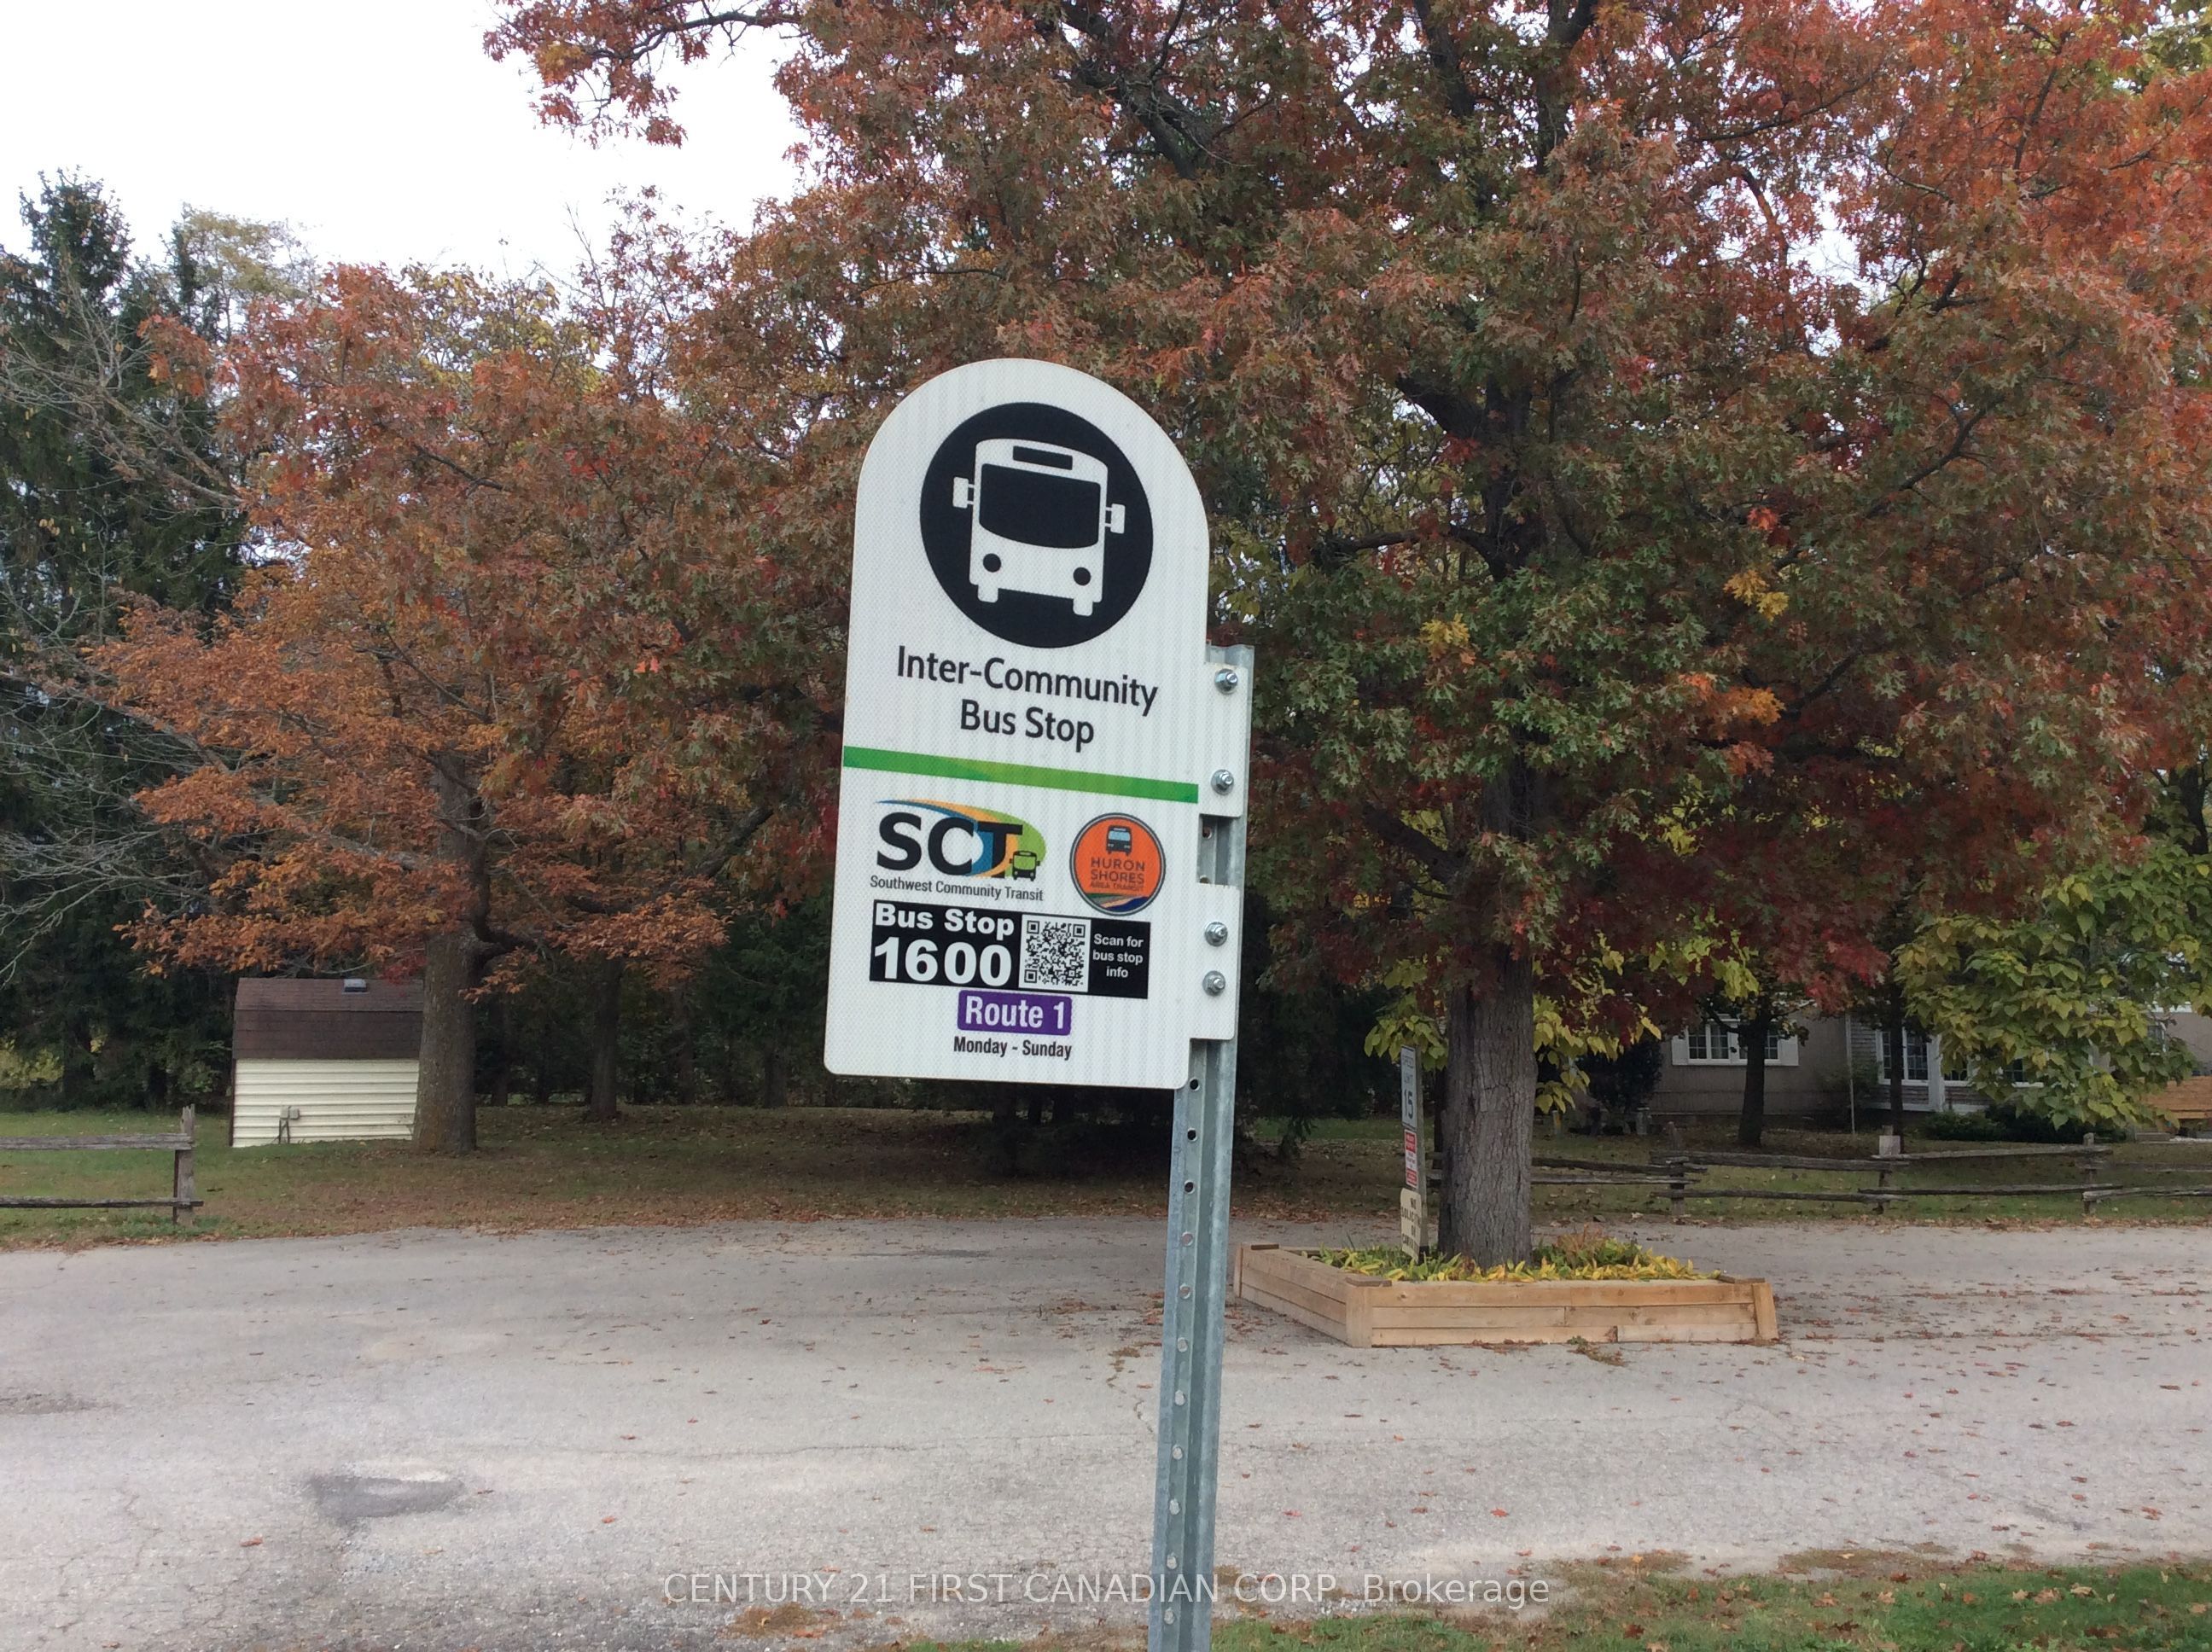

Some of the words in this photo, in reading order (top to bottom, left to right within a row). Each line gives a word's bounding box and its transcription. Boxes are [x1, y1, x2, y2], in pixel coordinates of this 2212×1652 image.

[897, 645, 1158, 717] Inter-Community
[961, 699, 1016, 736] Bus
[1025, 707, 1095, 753] Stop
[876, 811, 1023, 879] SCT
[1091, 857, 1145, 872] HURON
[1091, 869, 1144, 884] SHORES
[870, 875, 933, 893] Southwest
[935, 881, 1001, 900] Community
[1004, 886, 1044, 901] Transit
[875, 903, 934, 930] Bus
[944, 908, 1015, 940] Stop
[1093, 934, 1124, 946] Scan
[1126, 936, 1144, 948] for
[874, 936, 1012, 986] 1600
[1092, 949, 1115, 962] bus
[1117, 952, 1144, 966] stop
[1106, 966, 1129, 978] info
[965, 995, 1044, 1028] Route
[1053, 1002, 1066, 1029] 1
[953, 1036, 1008, 1057] Monday
[1022, 1039, 1072, 1061] Sunday
